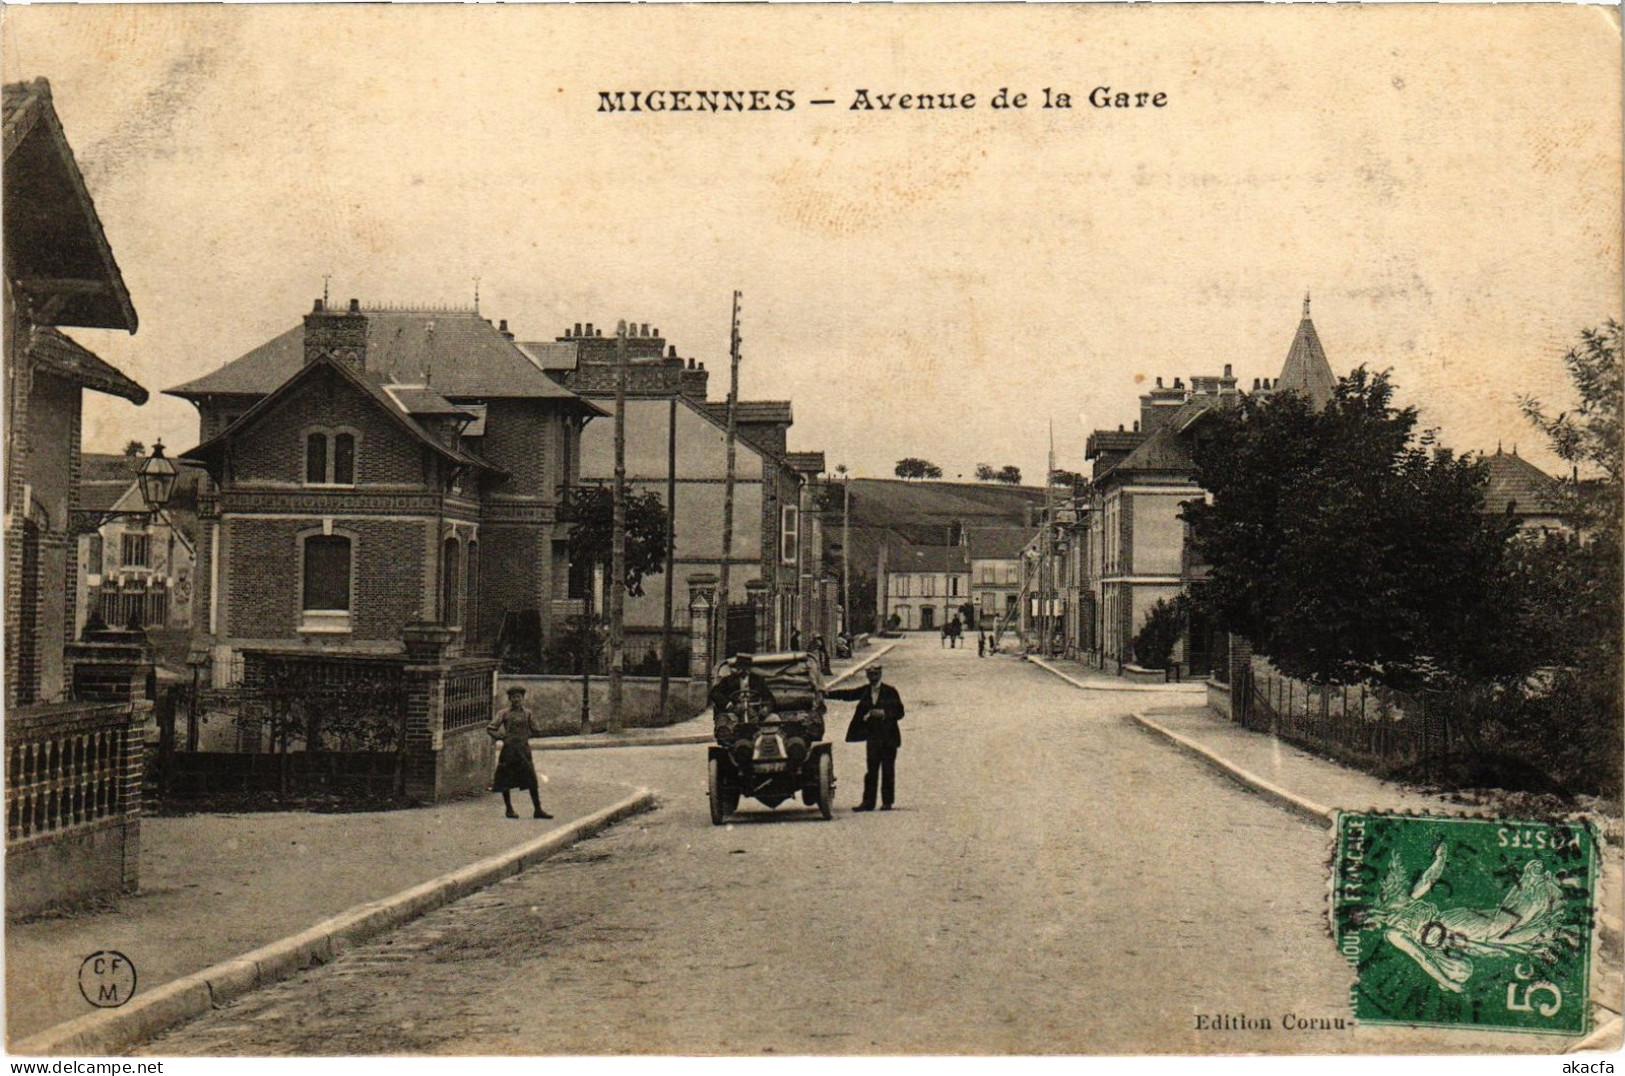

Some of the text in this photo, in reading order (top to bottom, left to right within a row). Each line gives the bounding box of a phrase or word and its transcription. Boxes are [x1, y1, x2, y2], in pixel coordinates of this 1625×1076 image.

[597, 89, 796, 113] MIGENNES
[850, 89, 976, 110] Avenue
[990, 87, 1028, 110] de
[1042, 87, 1073, 109] la
[1088, 86, 1169, 108] Gare
[99, 984, 118, 1002] M
[1195, 1014, 1272, 1031] Edition
